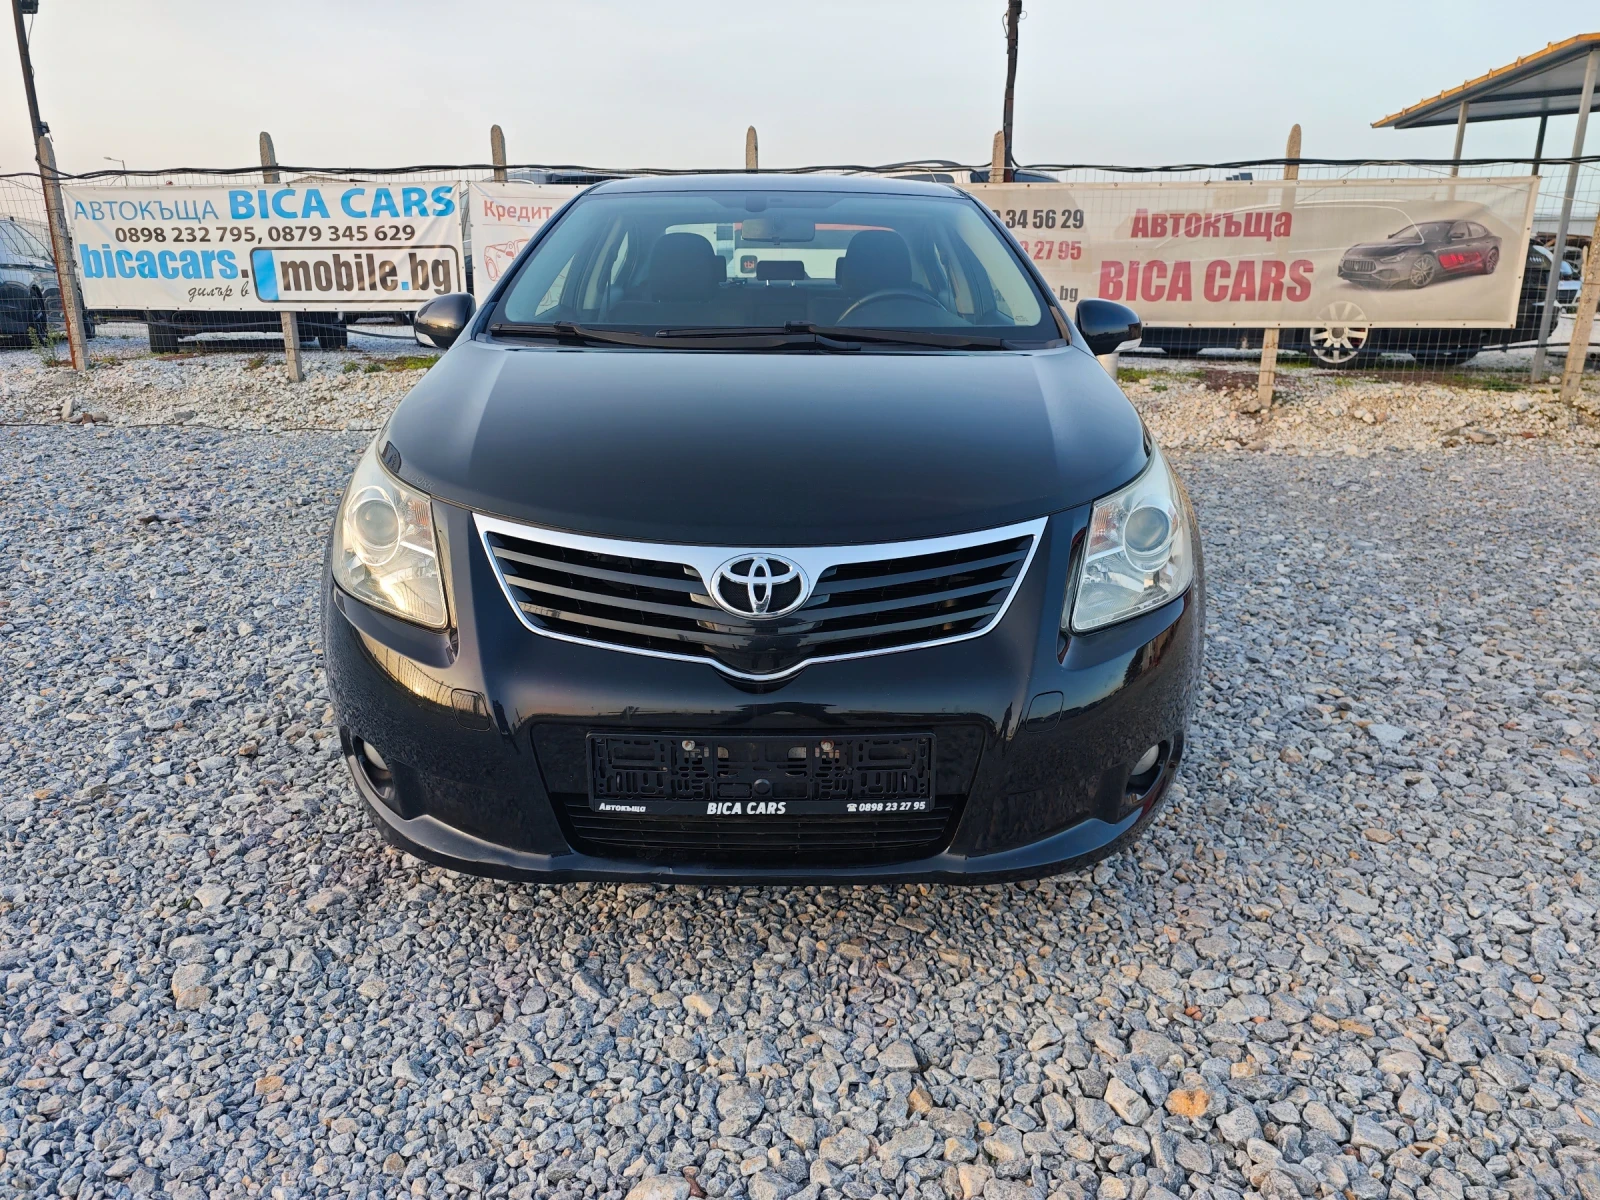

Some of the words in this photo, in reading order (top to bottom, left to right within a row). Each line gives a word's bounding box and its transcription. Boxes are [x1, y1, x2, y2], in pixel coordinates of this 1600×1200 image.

[74, 200, 219, 224] АВТОКЪЩА
[228, 188, 331, 220] BICA
[340, 186, 456, 218] CARS
[483, 200, 553, 222] Кредит
[1005, 209, 1028, 229] 34
[1032, 209, 1057, 229] 56
[1060, 209, 1085, 229] 29
[1130, 208, 1293, 242] Автокъща
[115, 227, 167, 243] 0898
[171, 227, 211, 242] 232
[267, 226, 322, 242] 0879
[328, 225, 368, 241] 345
[374, 225, 416, 241] 629
[1033, 241, 1055, 260] 27
[1058, 241, 1082, 260] 95
[280, 252, 452, 296] mobile.bg
[1098, 260, 1193, 303] BICA
[1203, 260, 1314, 303] CARS
[188, 284, 233, 302] дилър
[240, 281, 250, 297] в
[599, 802, 646, 813] Автокъща
[706, 802, 742, 815] BICA
[746, 802, 787, 815] CARS
[858, 803, 884, 812] 0898
[885, 802, 898, 811] 23
[899, 802, 911, 811] 27
[913, 801, 926, 811] 95
